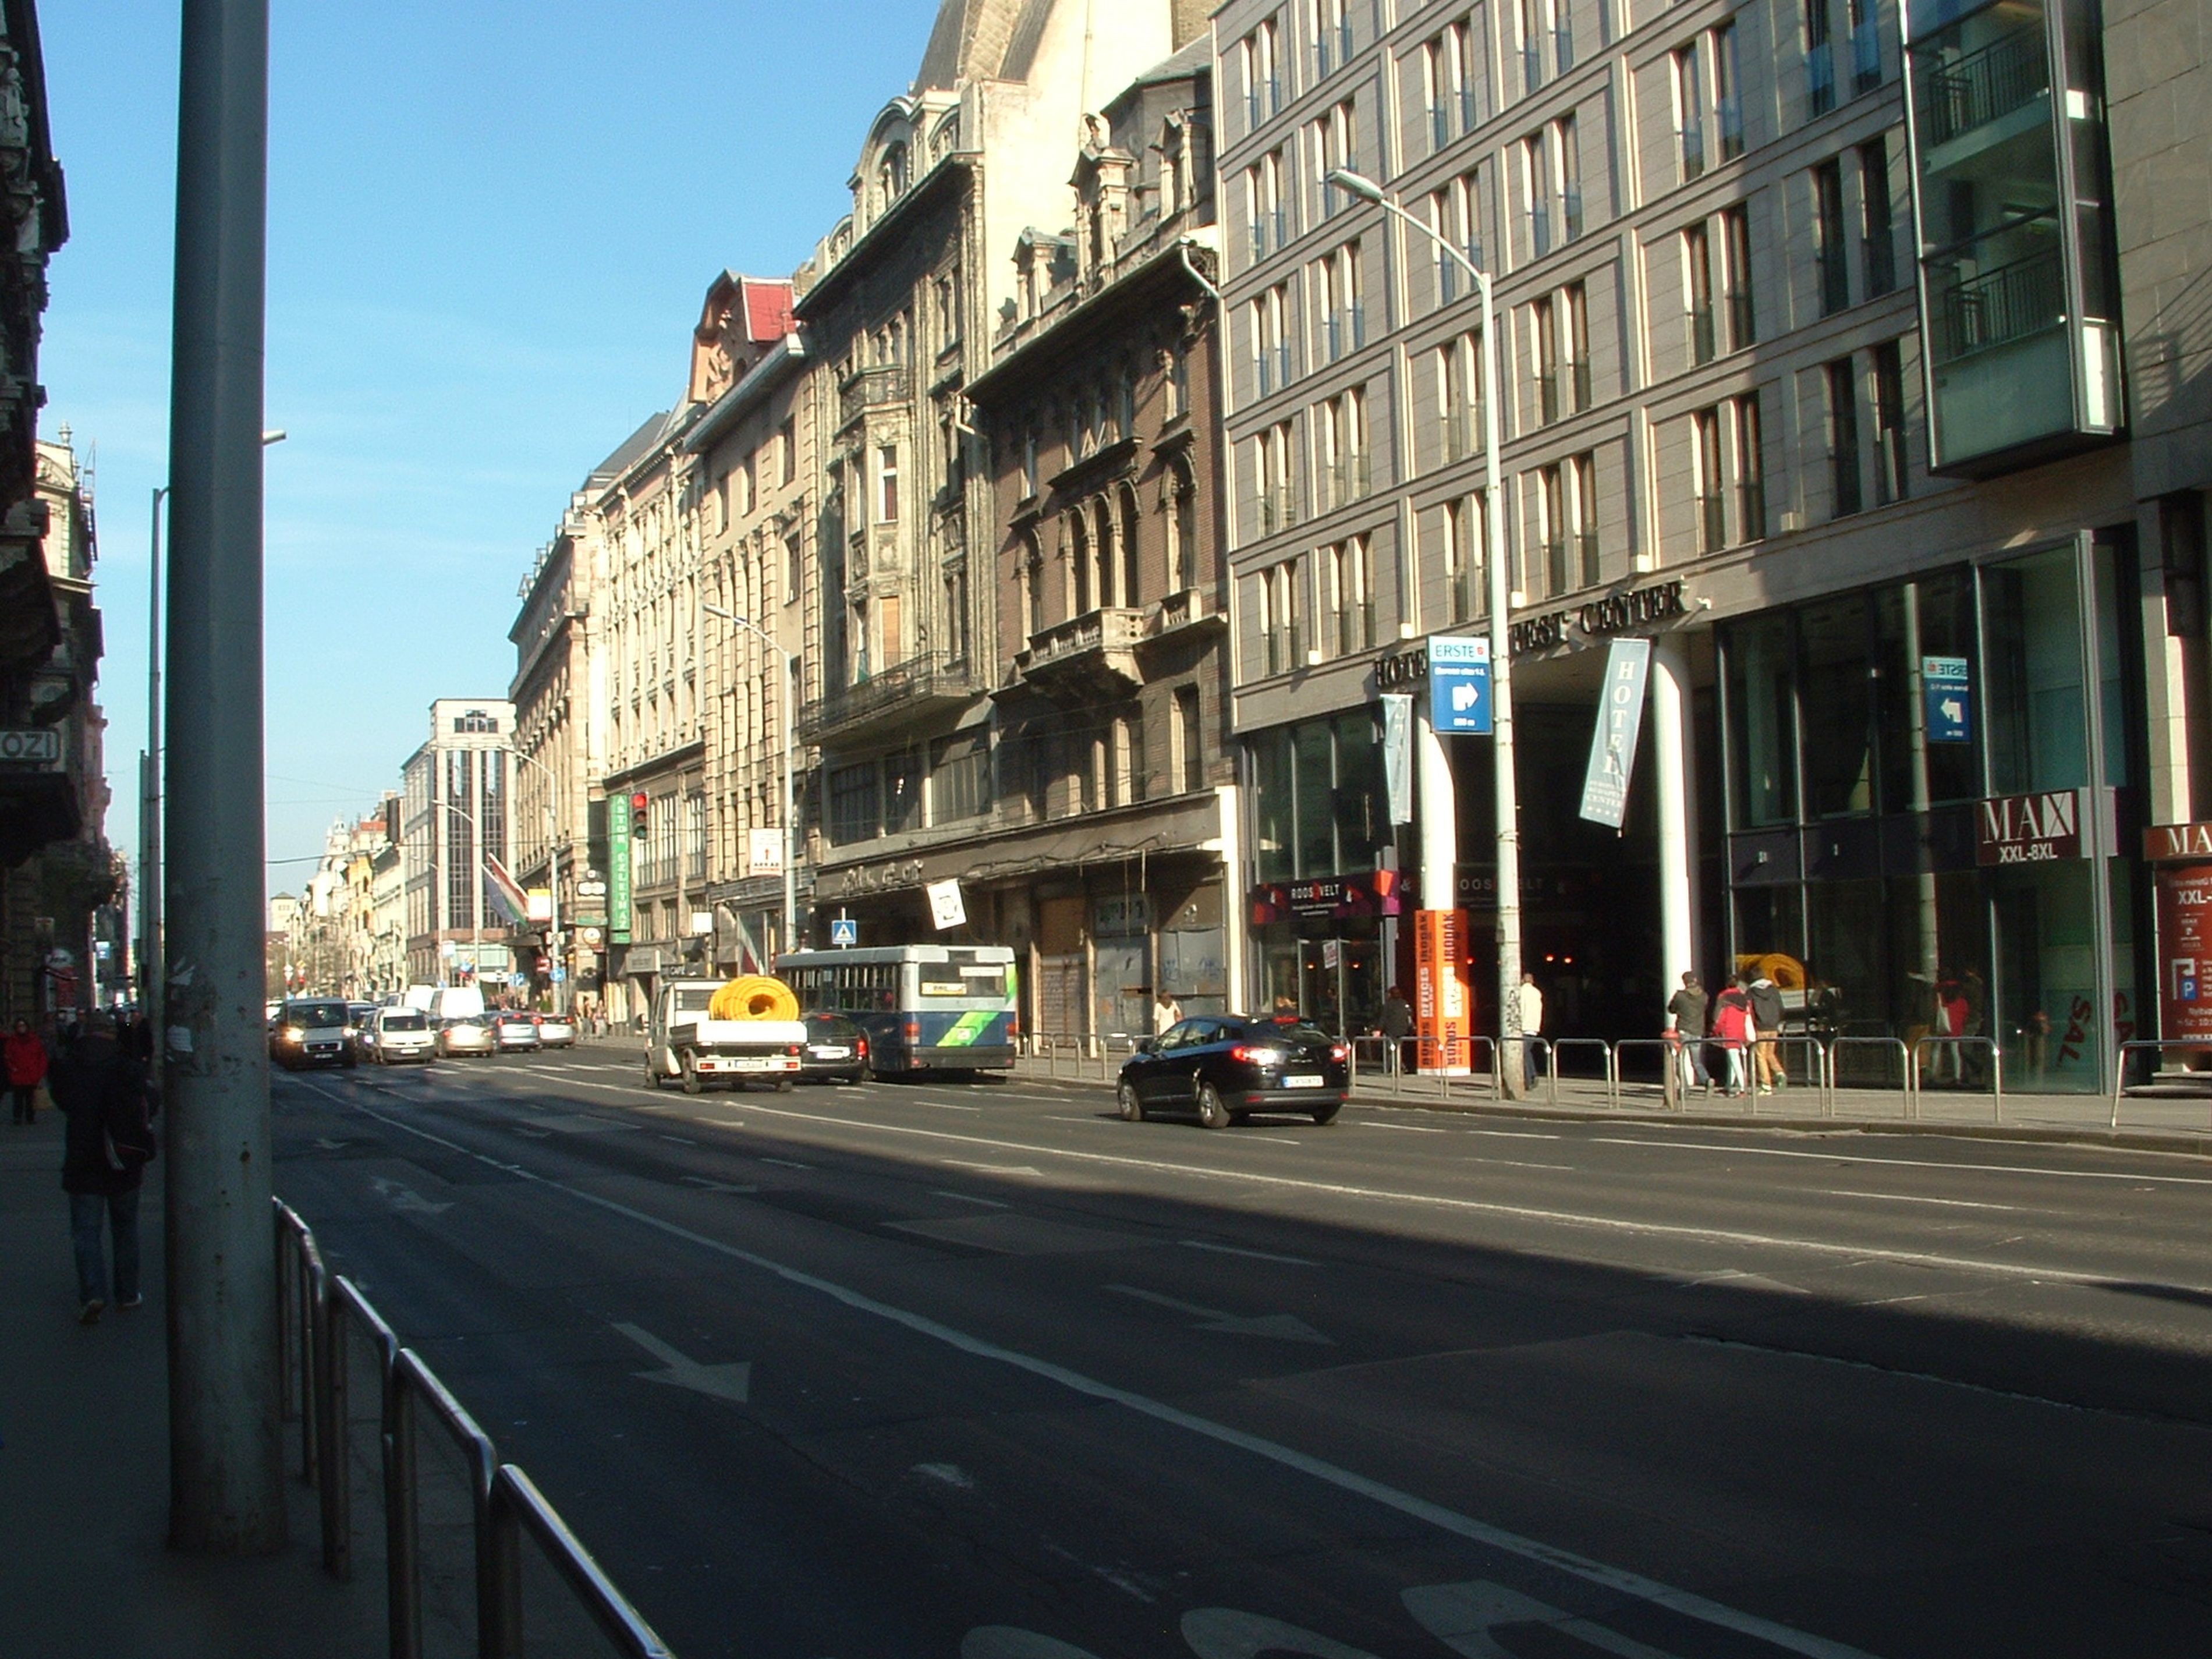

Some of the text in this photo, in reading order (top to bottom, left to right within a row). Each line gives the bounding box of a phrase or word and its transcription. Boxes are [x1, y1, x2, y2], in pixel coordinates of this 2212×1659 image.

[1374, 649, 1428, 686] HOTE
[1581, 581, 1685, 634] CENTER
[1435, 644, 1474, 657] ERSTE
[1603, 661, 1635, 775] HOTEL
[1981, 792, 2074, 843] MAX
[2000, 843, 2058, 863] XXL-8XL
[2167, 825, 2212, 856] MA
[2185, 982, 2194, 997] P
